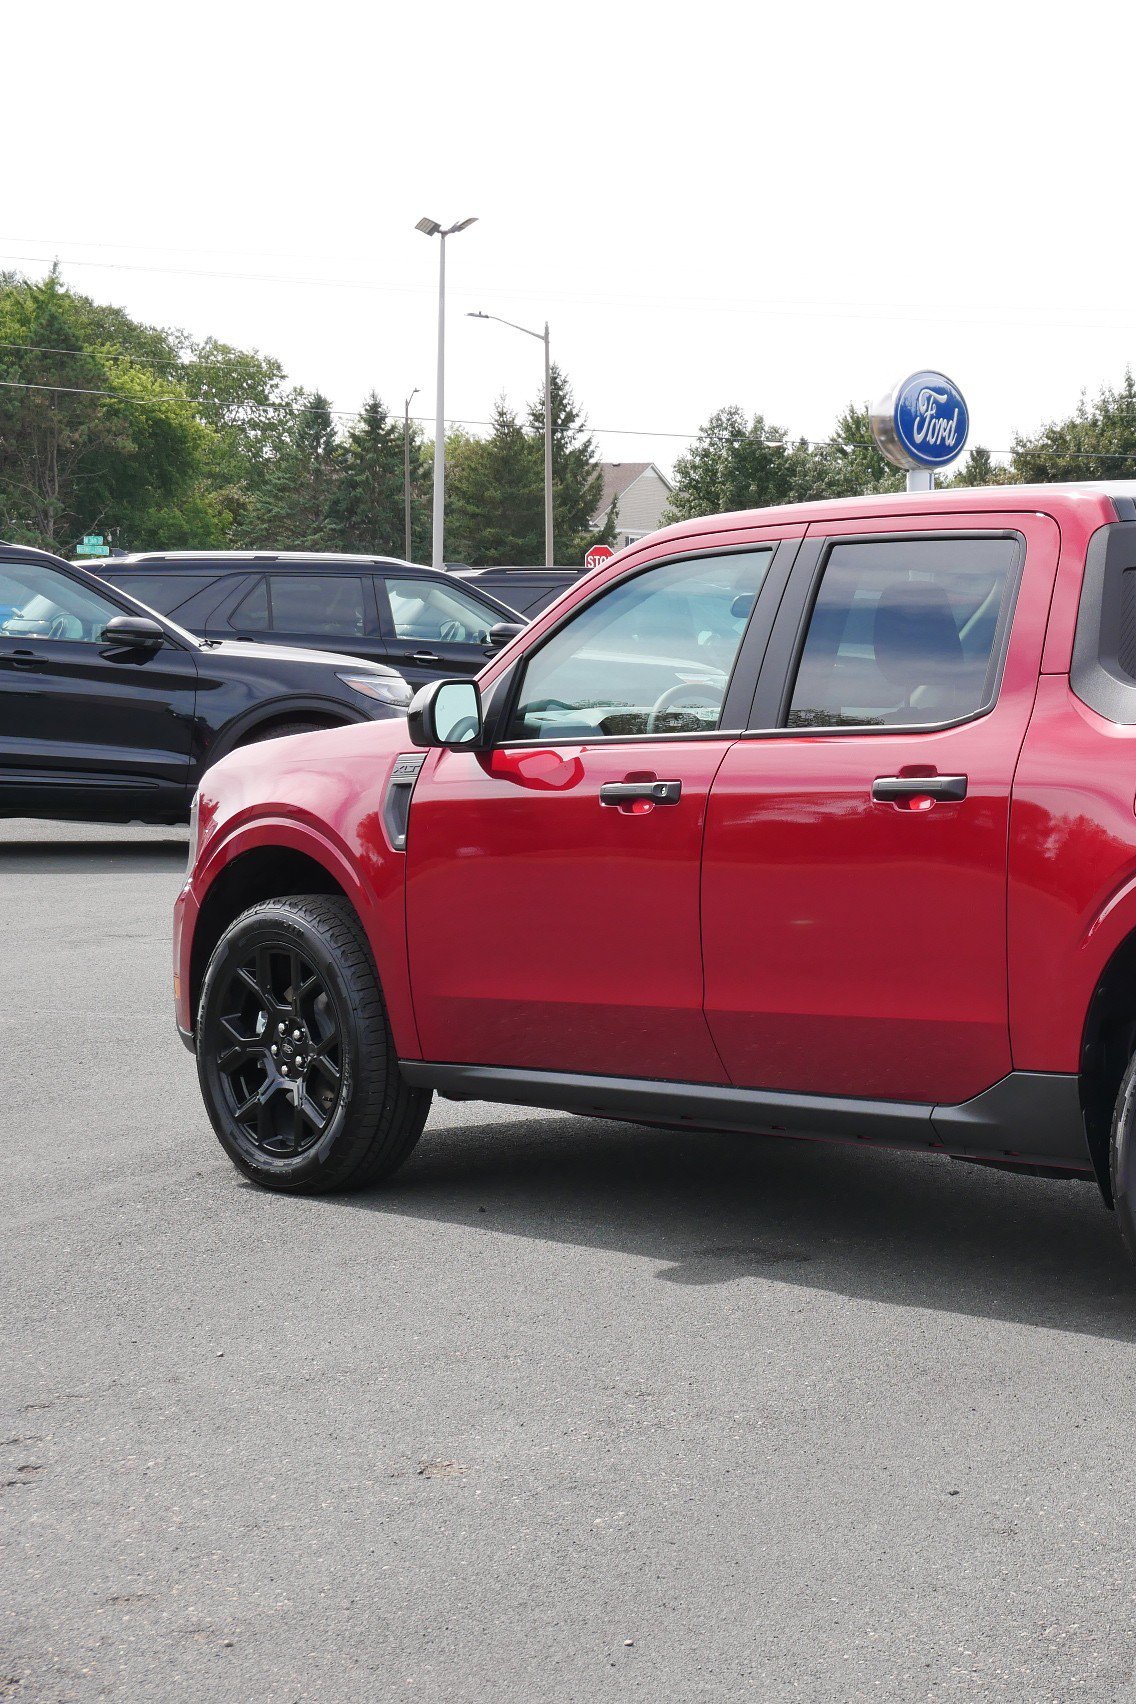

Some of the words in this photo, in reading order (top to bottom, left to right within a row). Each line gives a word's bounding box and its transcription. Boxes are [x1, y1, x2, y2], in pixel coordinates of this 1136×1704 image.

[914, 388, 958, 446] Ford
[588, 556, 610, 568] STO
[393, 765, 421, 774] XLT
